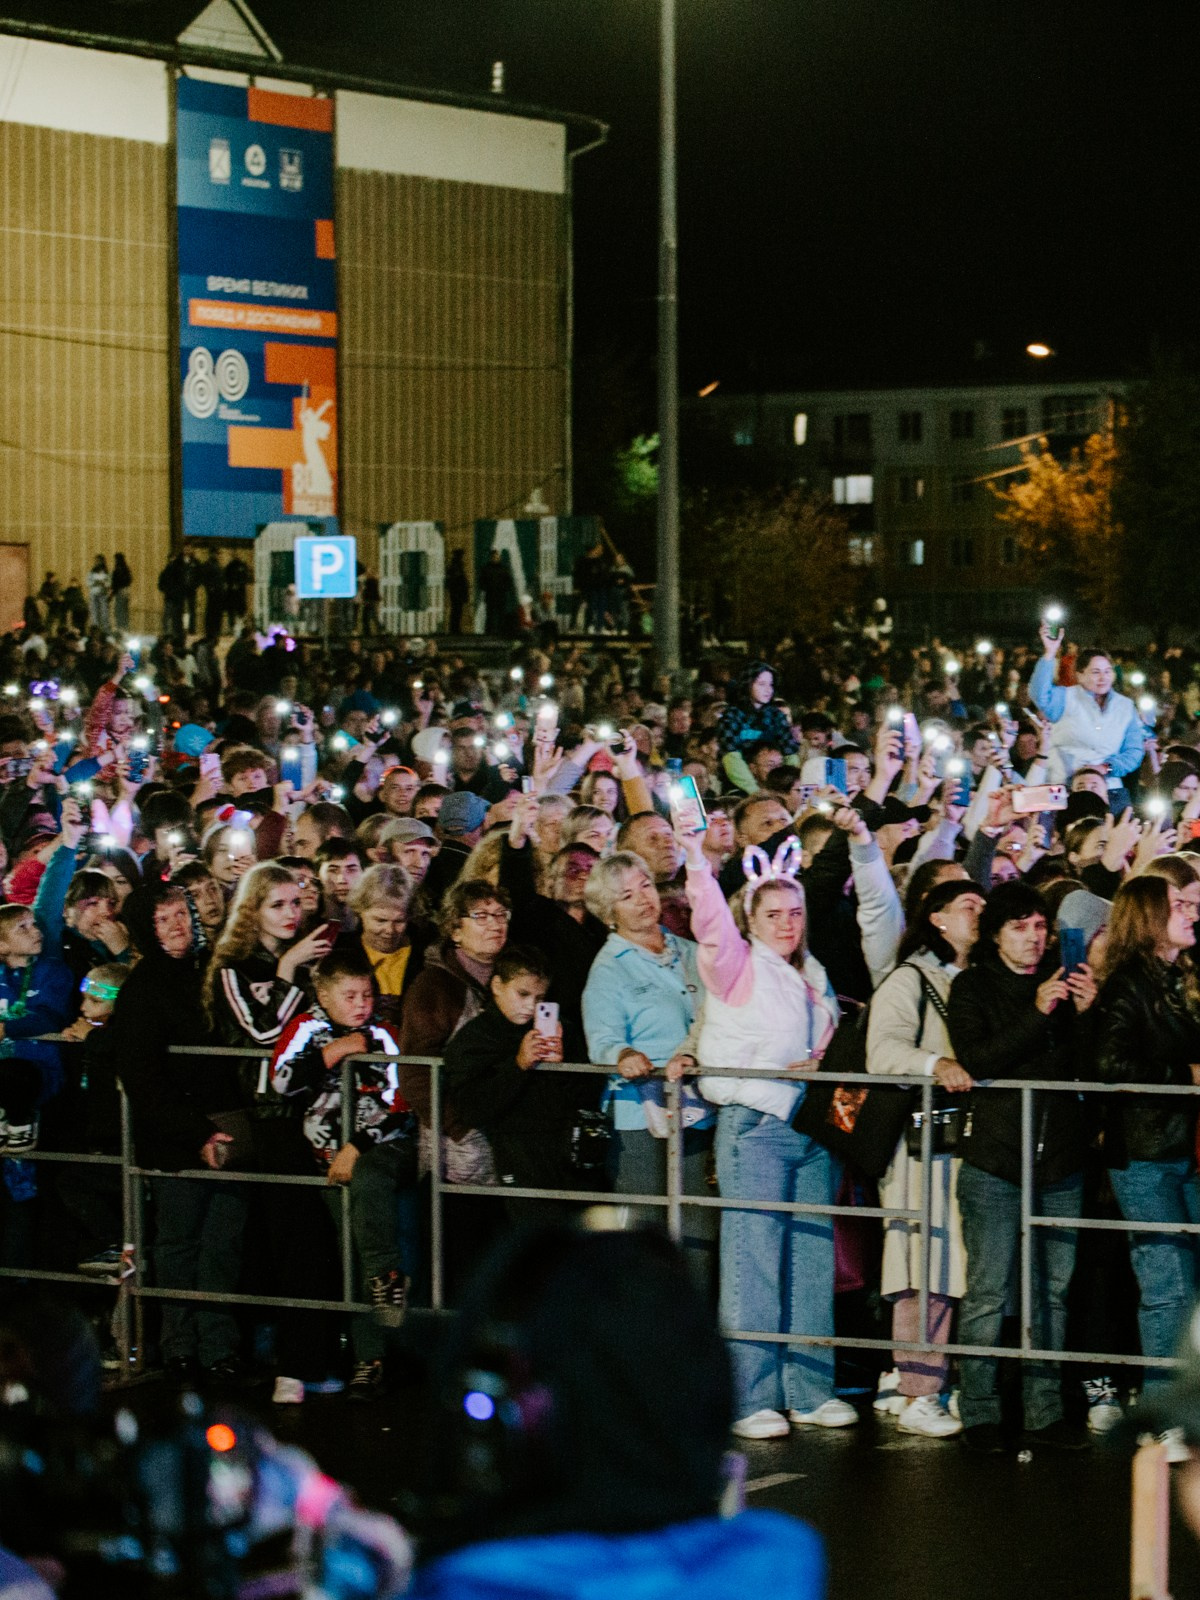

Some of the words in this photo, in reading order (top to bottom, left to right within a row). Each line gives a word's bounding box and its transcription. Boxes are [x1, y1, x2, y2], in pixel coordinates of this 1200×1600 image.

[207, 275, 250, 293] ВРЕМЯ
[183, 346, 249, 418] 80
[312, 544, 344, 590] P
